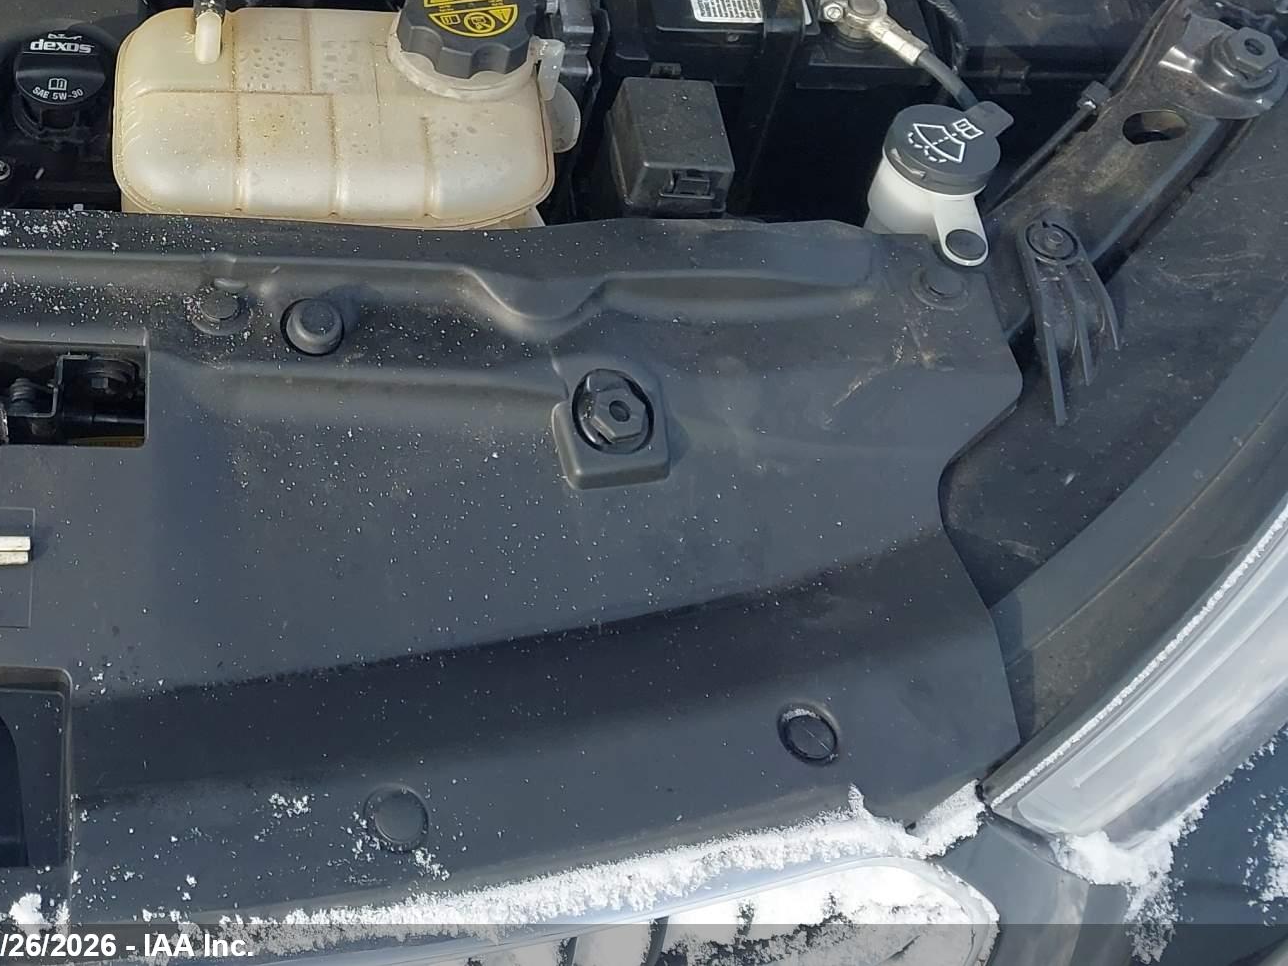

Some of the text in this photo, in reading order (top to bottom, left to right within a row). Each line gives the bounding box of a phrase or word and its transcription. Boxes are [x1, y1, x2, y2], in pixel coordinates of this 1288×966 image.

[30, 38, 93, 53] dexos
[32, 87, 84, 101] SAE 5W-30
